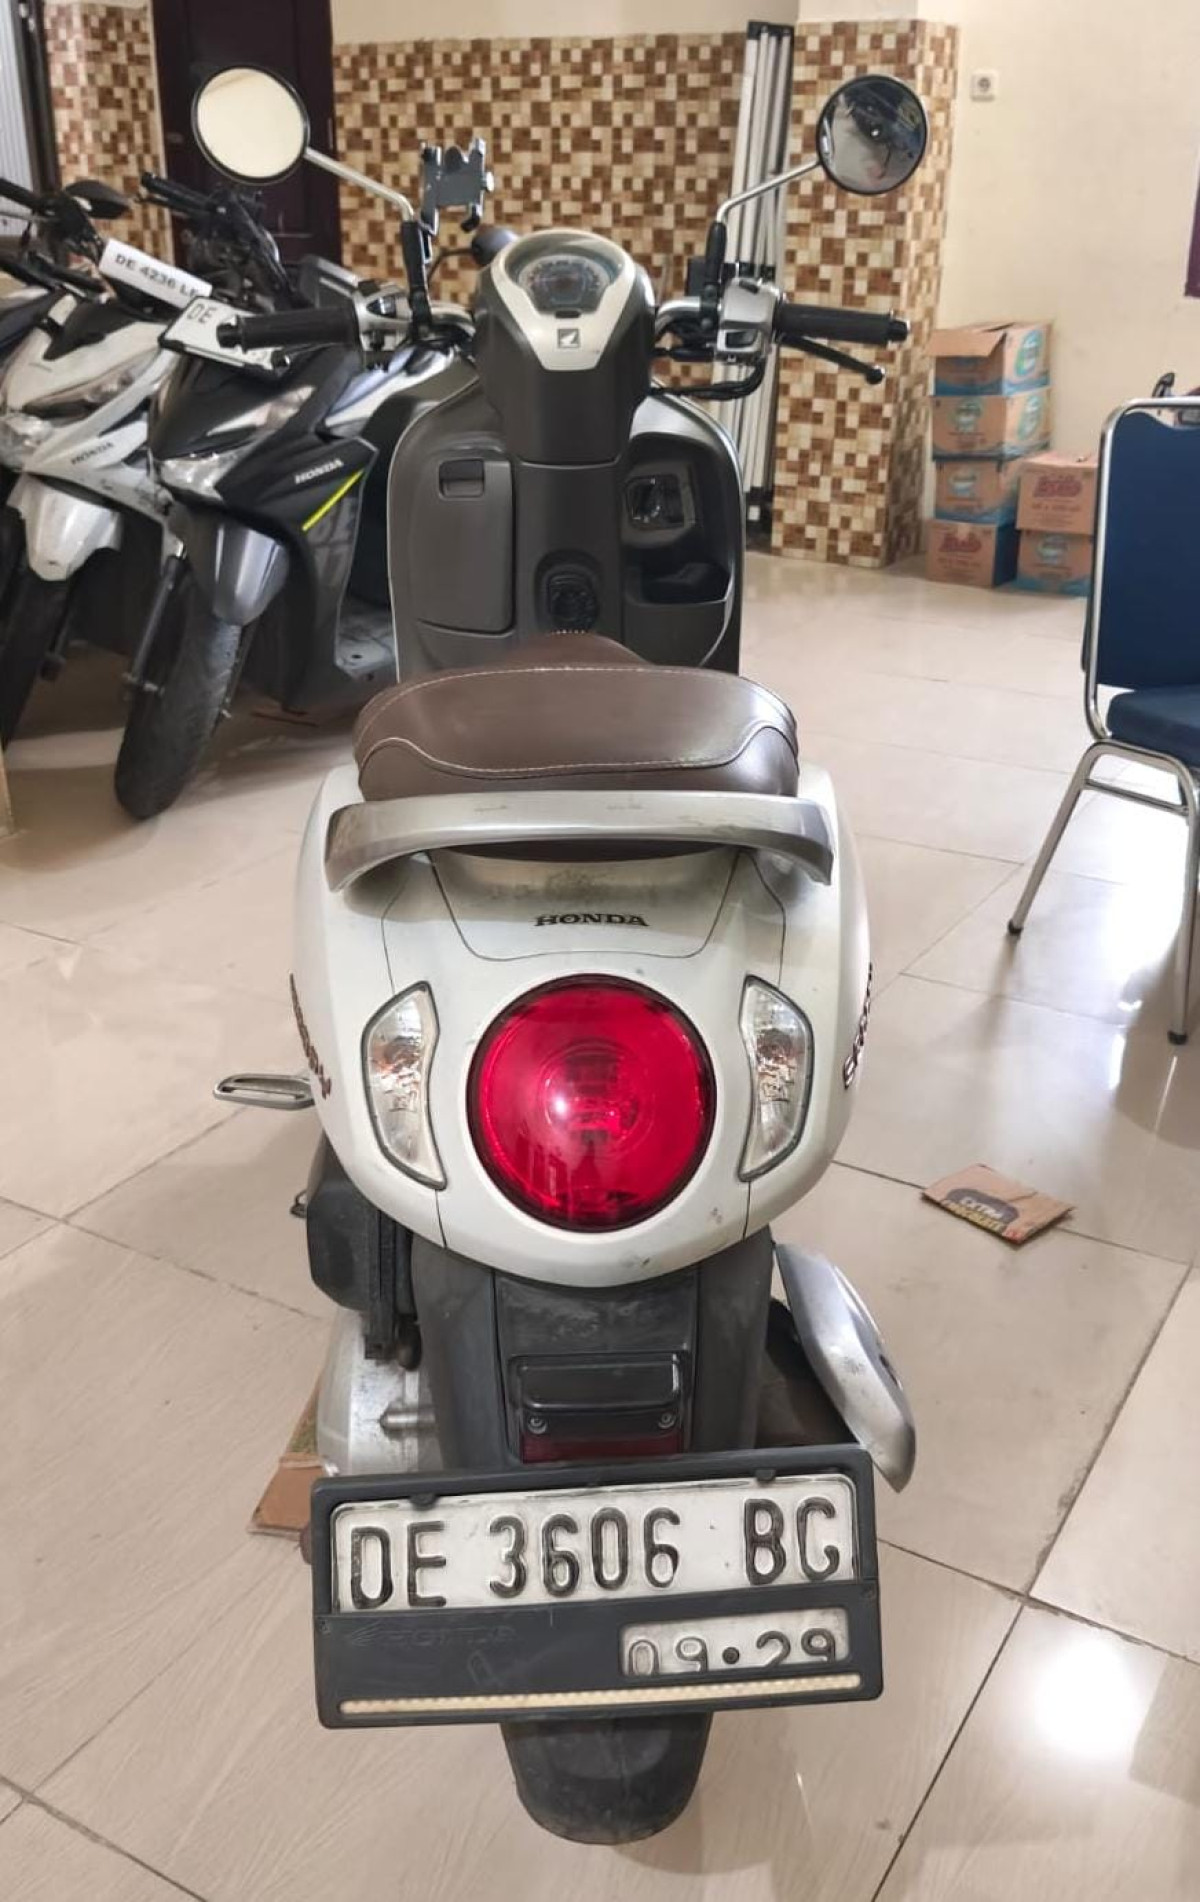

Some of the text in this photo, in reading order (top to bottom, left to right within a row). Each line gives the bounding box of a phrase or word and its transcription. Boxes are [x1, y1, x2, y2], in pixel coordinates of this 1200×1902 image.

[115, 253, 136, 271] DE
[187, 303, 217, 323] DE
[294, 458, 344, 484] HONDA
[534, 913, 650, 927] HONDA
[351, 1520, 446, 1609] DE
[490, 1507, 680, 1598] 3606
